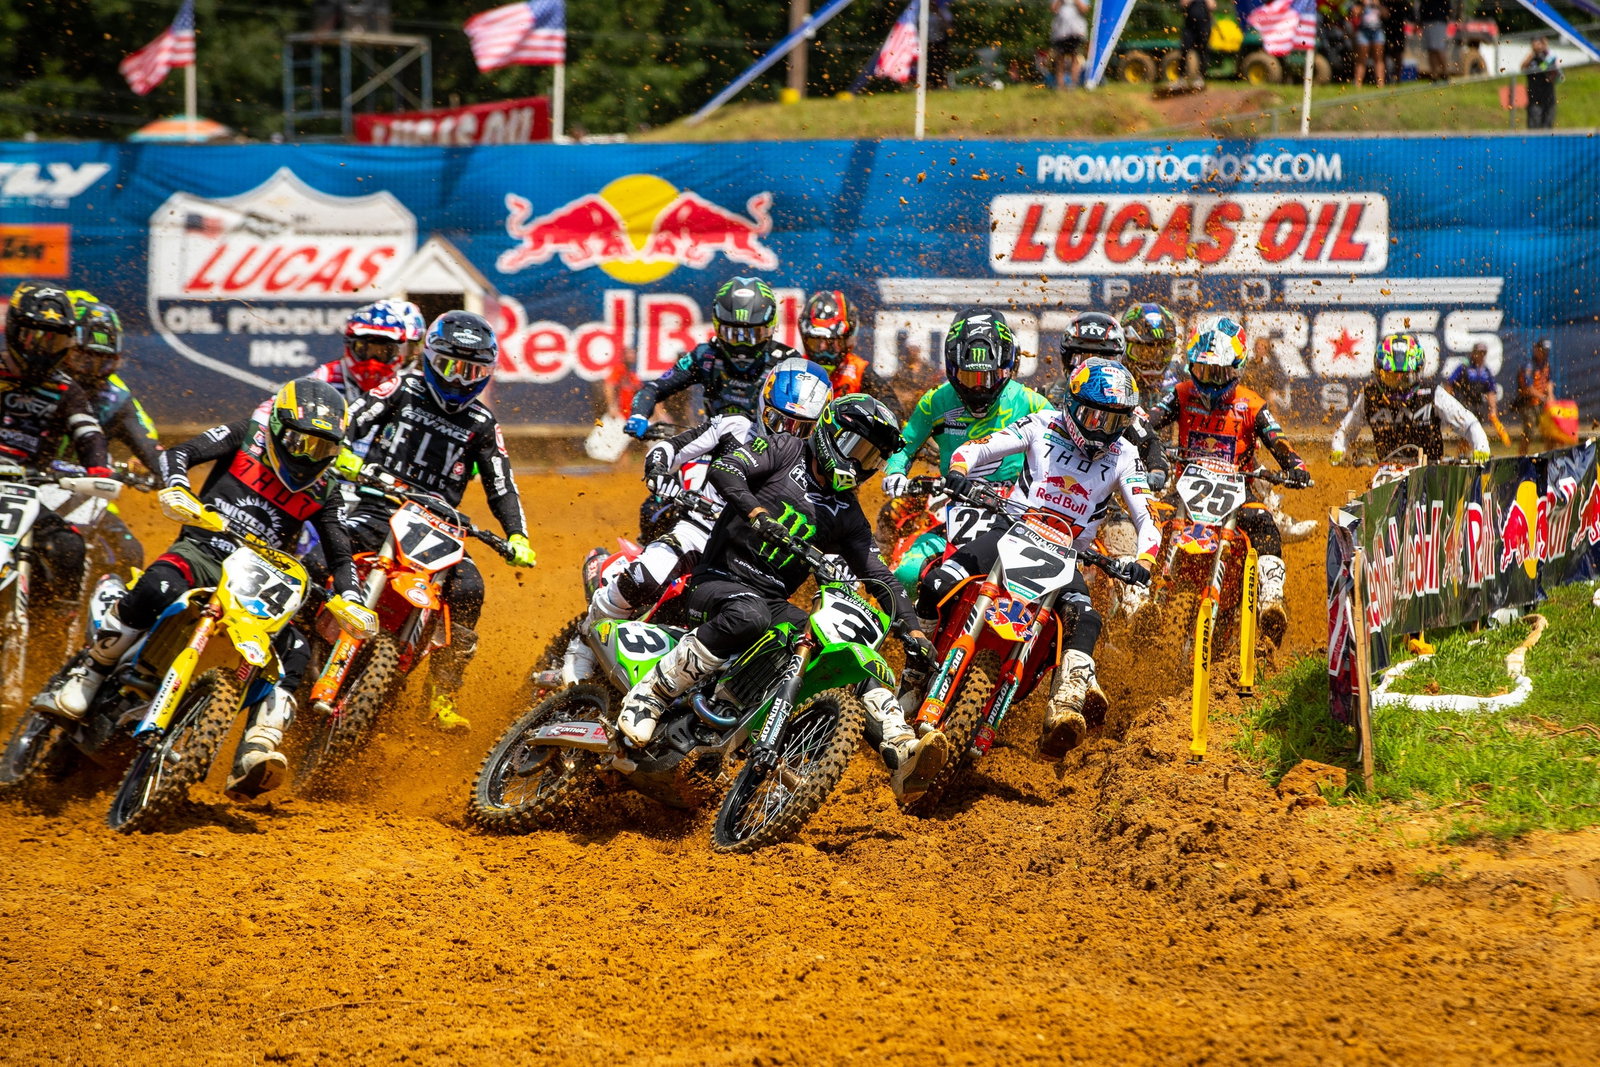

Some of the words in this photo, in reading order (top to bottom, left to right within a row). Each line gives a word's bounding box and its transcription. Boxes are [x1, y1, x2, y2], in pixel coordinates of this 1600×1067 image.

[1009, 202, 1245, 263] LUCAS
[1258, 202, 1369, 263] OIL
[183, 244, 395, 292] LUCAS
[1105, 279, 1271, 303] PRO
[164, 307, 223, 335] OIL
[491, 292, 637, 383] Red
[389, 421, 465, 476] FLY
[384, 456, 446, 490] RACING
[1035, 487, 1063, 505] Red
[1062, 497, 1087, 516] Bull
[1186, 479, 1239, 516] 25
[399, 520, 462, 565] 17
[229, 562, 295, 616] 34
[1005, 547, 1066, 595] 2
[1247, 564, 1256, 614] ACERBIS
[831, 601, 878, 648] 3
[844, 596, 866, 610] LUCAS
[864, 609, 874, 619] OIL
[618, 627, 667, 654] 3
[1201, 616, 1210, 673] ACERBIS
[760, 697, 783, 742] DUNLOP
